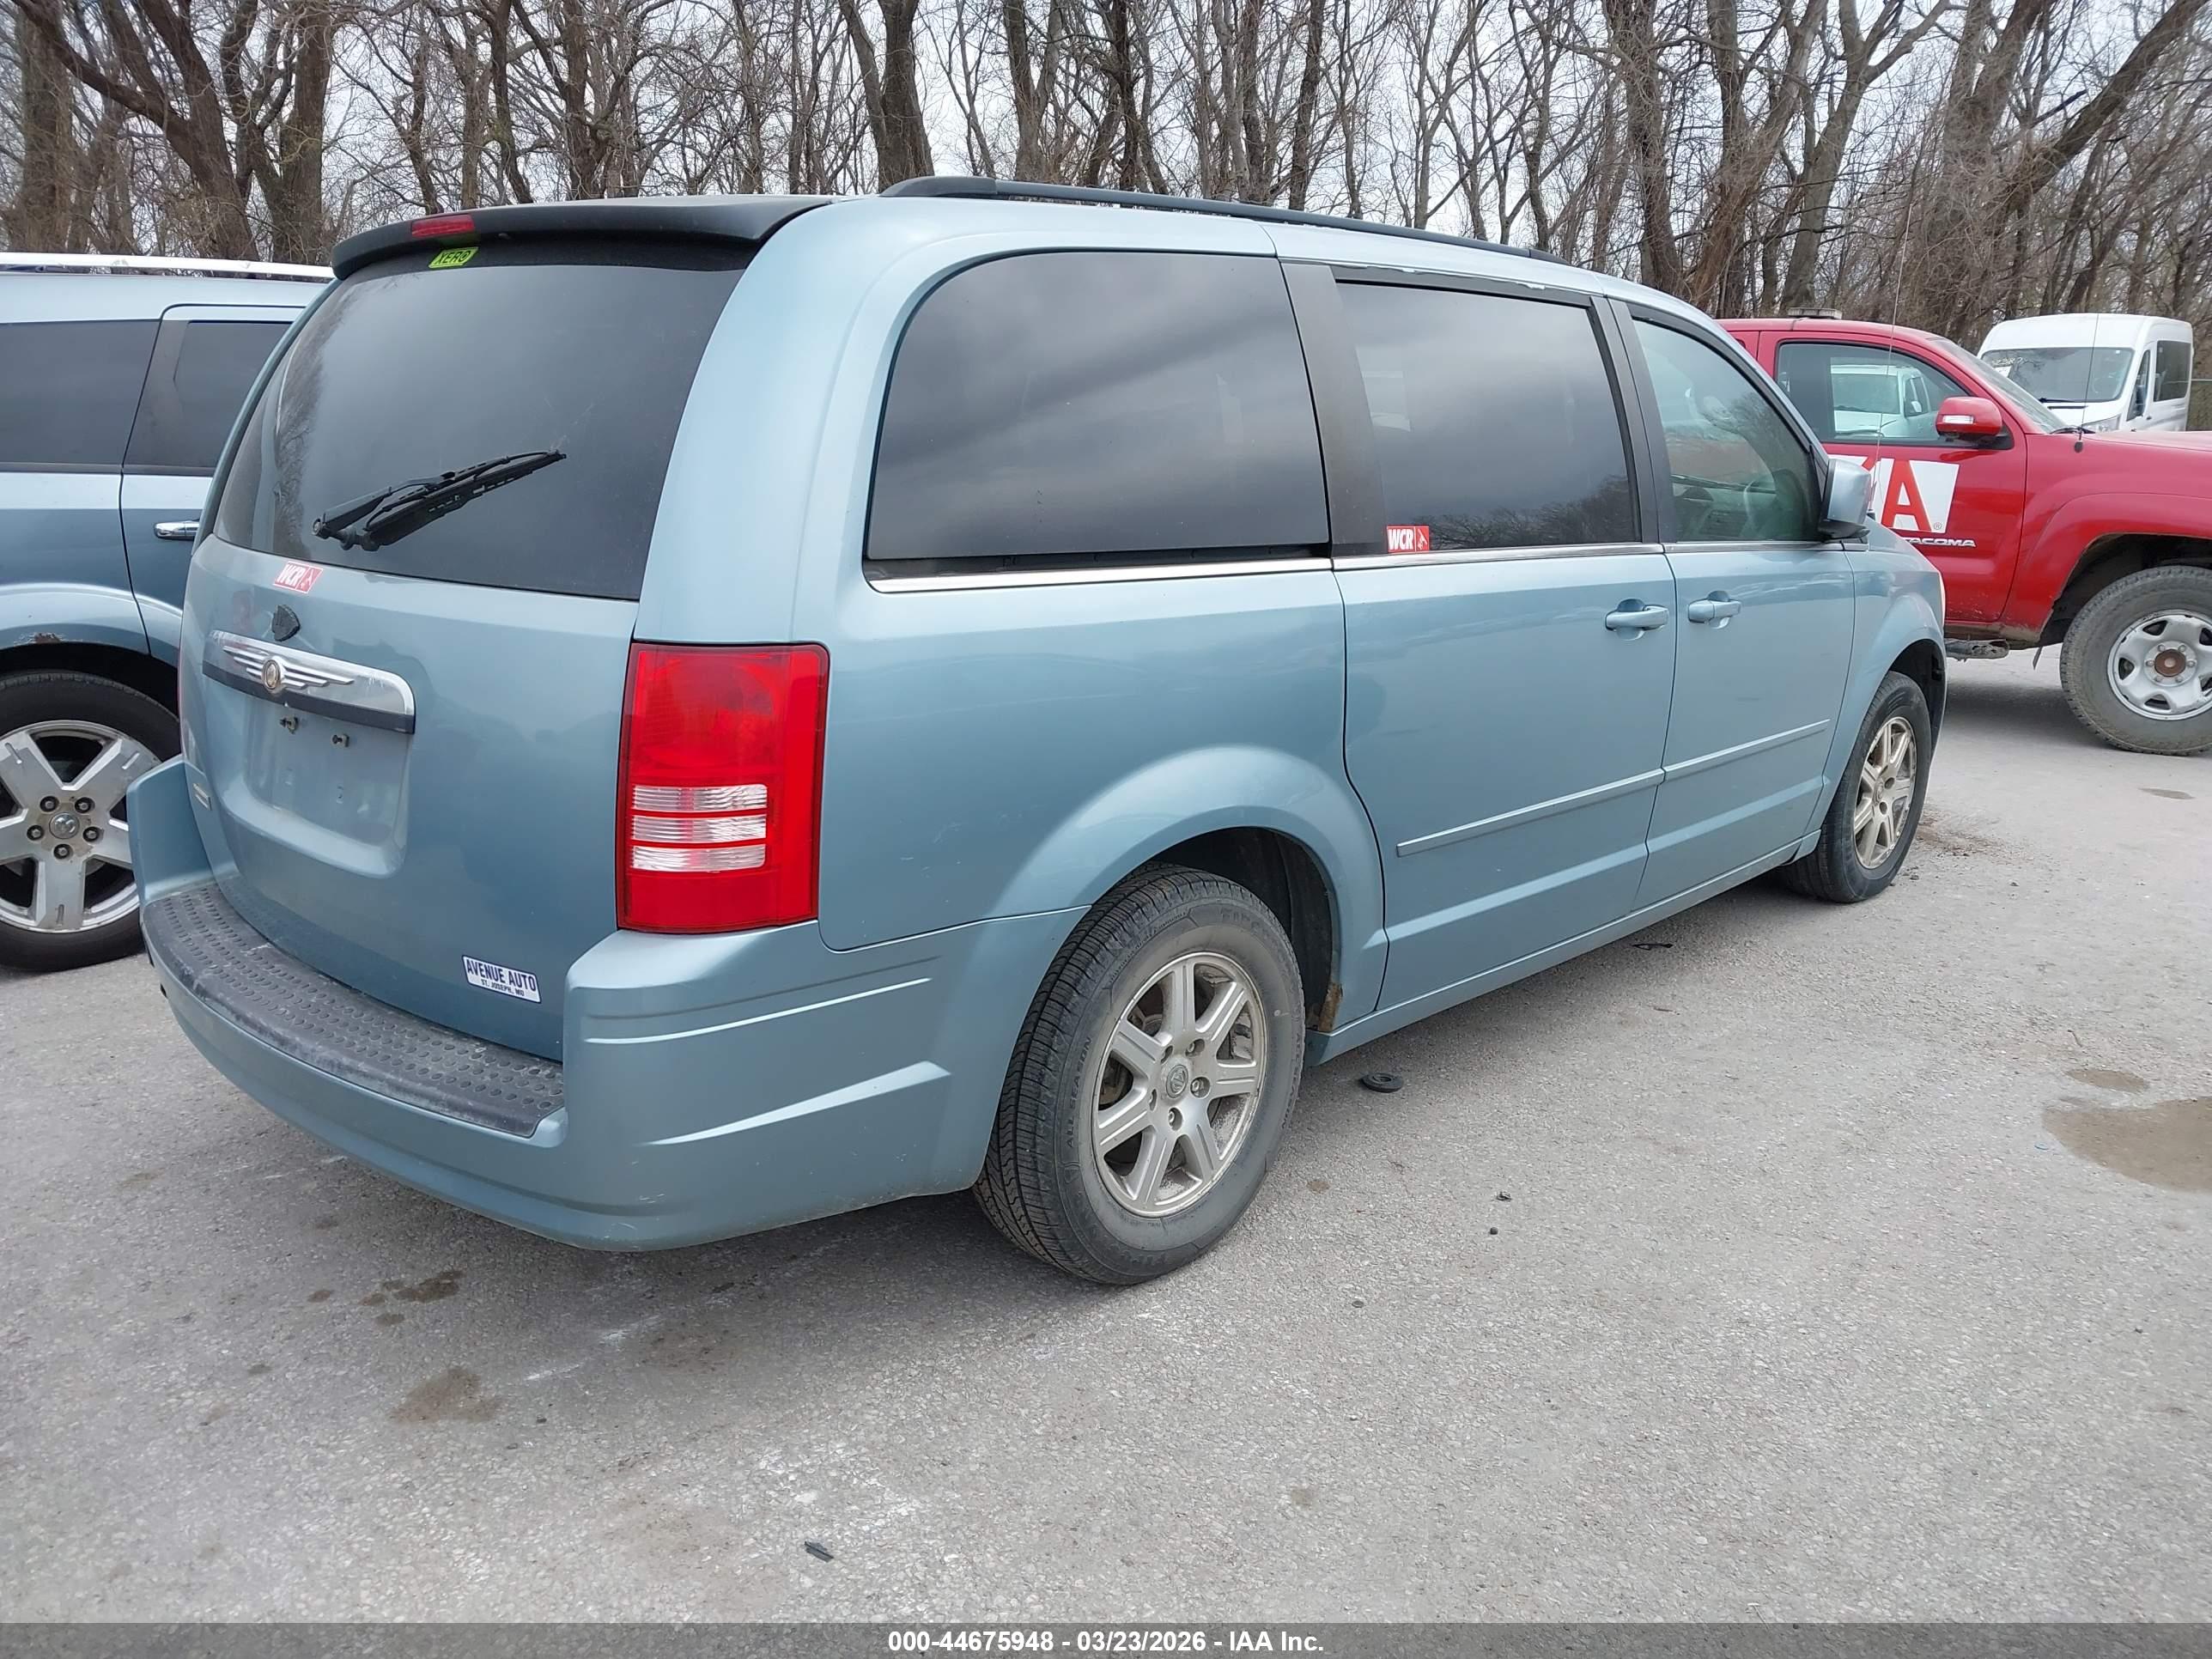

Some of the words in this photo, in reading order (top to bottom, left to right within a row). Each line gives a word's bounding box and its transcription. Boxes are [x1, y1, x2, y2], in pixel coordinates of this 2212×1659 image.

[1387, 528, 1414, 550] WCR
[1902, 537, 1977, 548] TACOMA
[465, 958, 507, 984] AVENUE
[507, 970, 537, 992] AUTO
